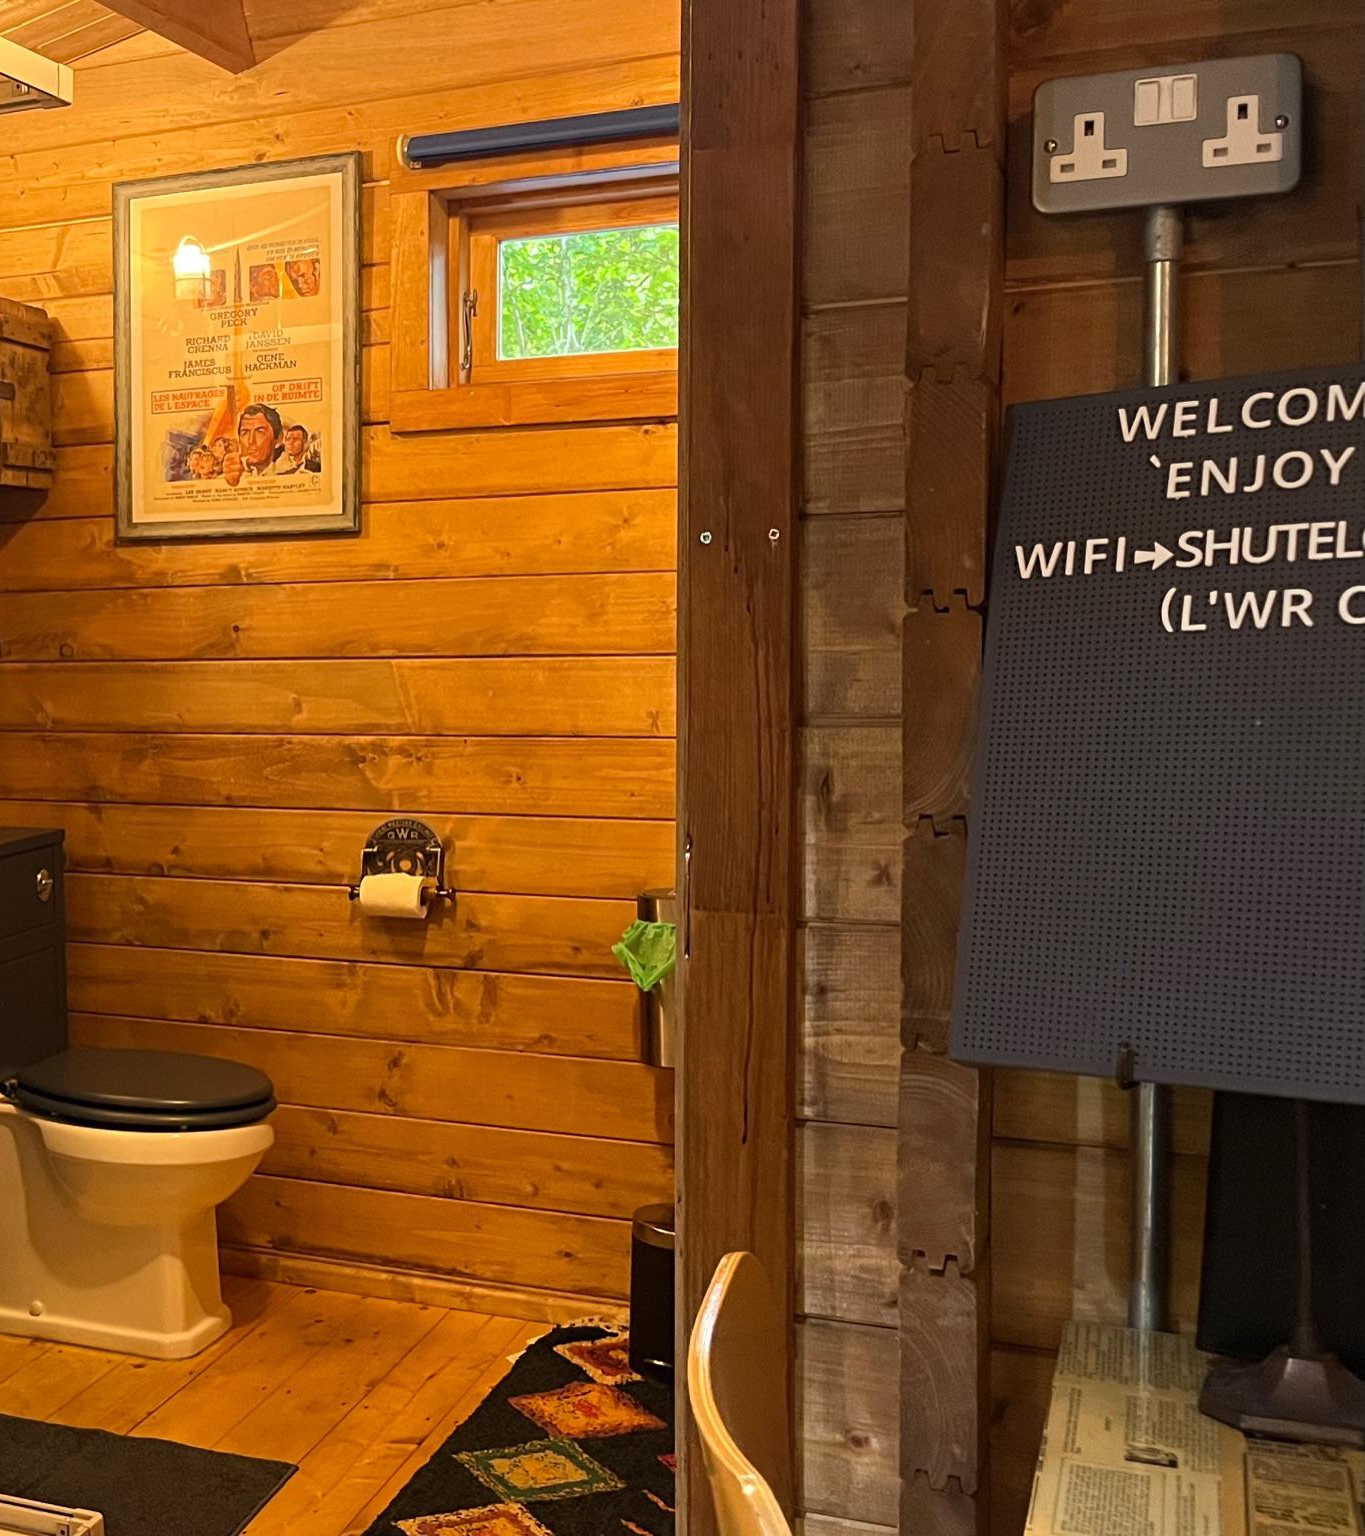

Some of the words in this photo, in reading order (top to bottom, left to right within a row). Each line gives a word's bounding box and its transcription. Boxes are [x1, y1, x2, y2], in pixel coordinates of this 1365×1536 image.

[210, 308, 258, 321] GREGORY
[221, 318, 247, 328] PECK
[186, 335, 230, 346] RICHARD
[252, 330, 283, 340] DAVID
[188, 344, 228, 354] CRENNA
[246, 338, 291, 349] JANSSEN
[257, 353, 285, 363] GENE
[183, 359, 216, 369] JAMES
[245, 360, 297, 372] HACKMAN
[169, 366, 232, 379] FRANCISCUS
[272, 383, 286, 392] OP
[289, 381, 319, 391] DRIFT
[154, 394, 170, 402] LES
[254, 394, 265, 403] IN
[267, 393, 280, 402] DE
[281, 390, 320, 401] RUIMTE
[154, 403, 165, 411] DE
[1117, 382, 1365, 444] WELCOM
[1174, 520, 1365, 568] SHUTEL
